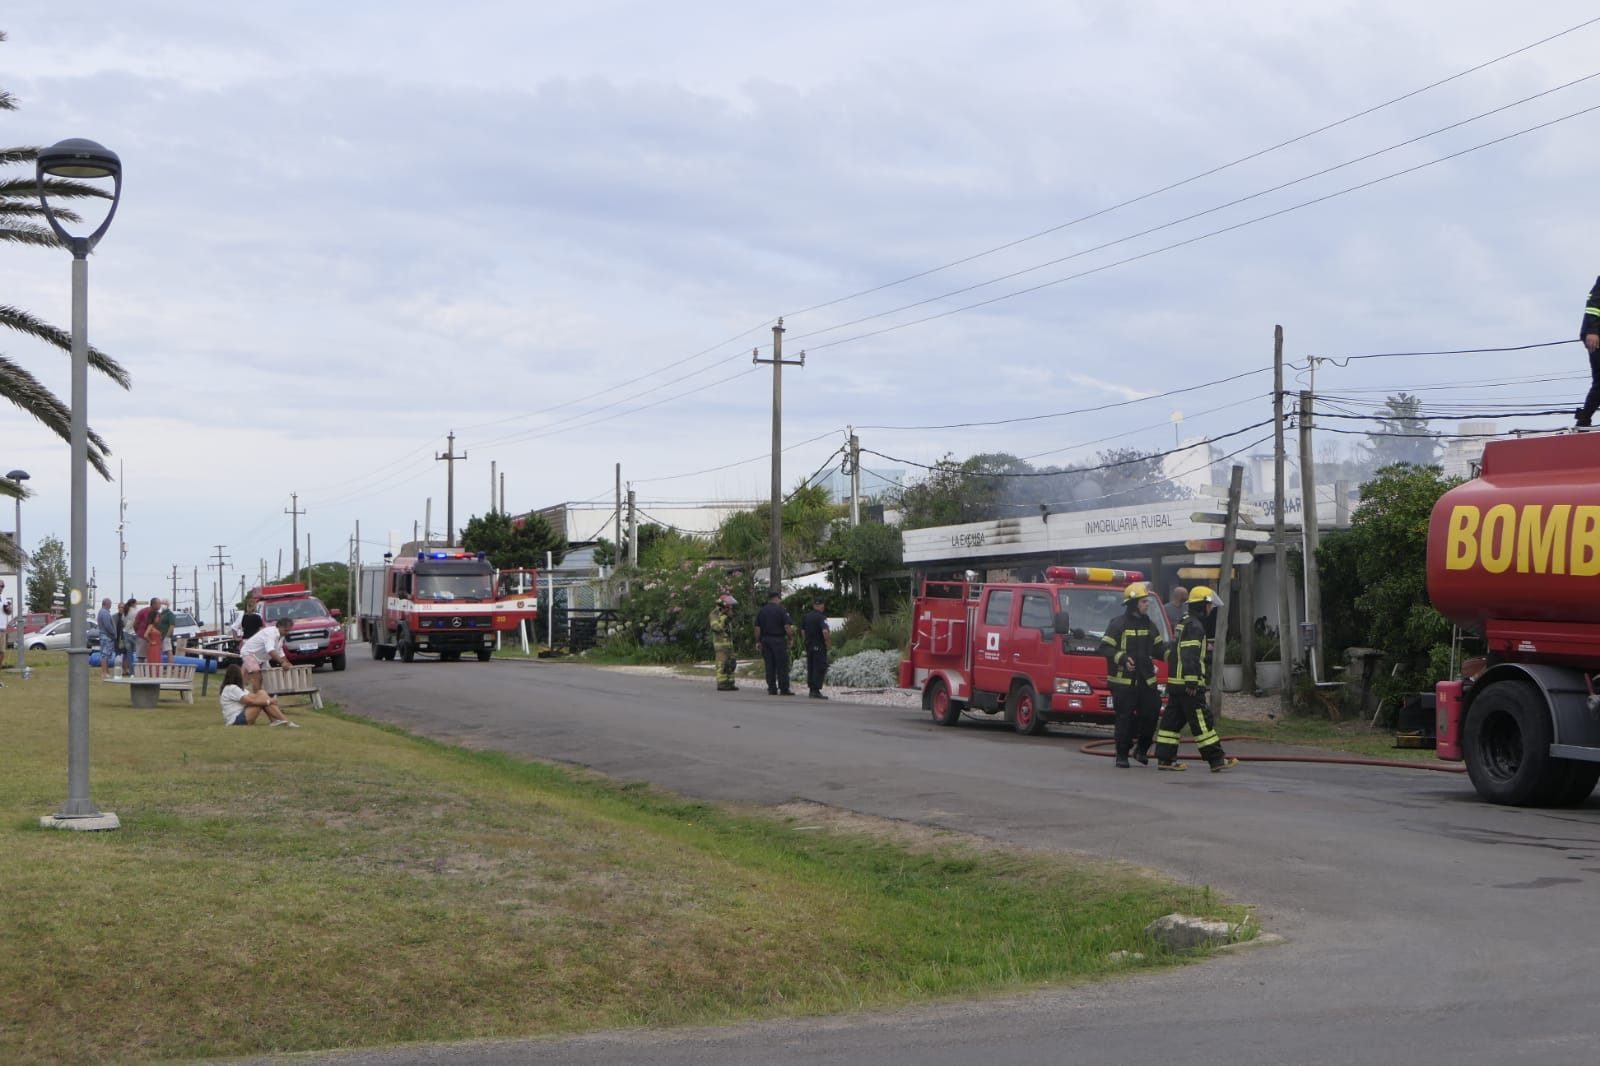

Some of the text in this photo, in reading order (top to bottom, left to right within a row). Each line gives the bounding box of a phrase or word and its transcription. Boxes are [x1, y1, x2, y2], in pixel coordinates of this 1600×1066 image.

[1085, 513, 1172, 535] INMOBILIARIA RUIBAL
[1445, 503, 1600, 576] BOMB
